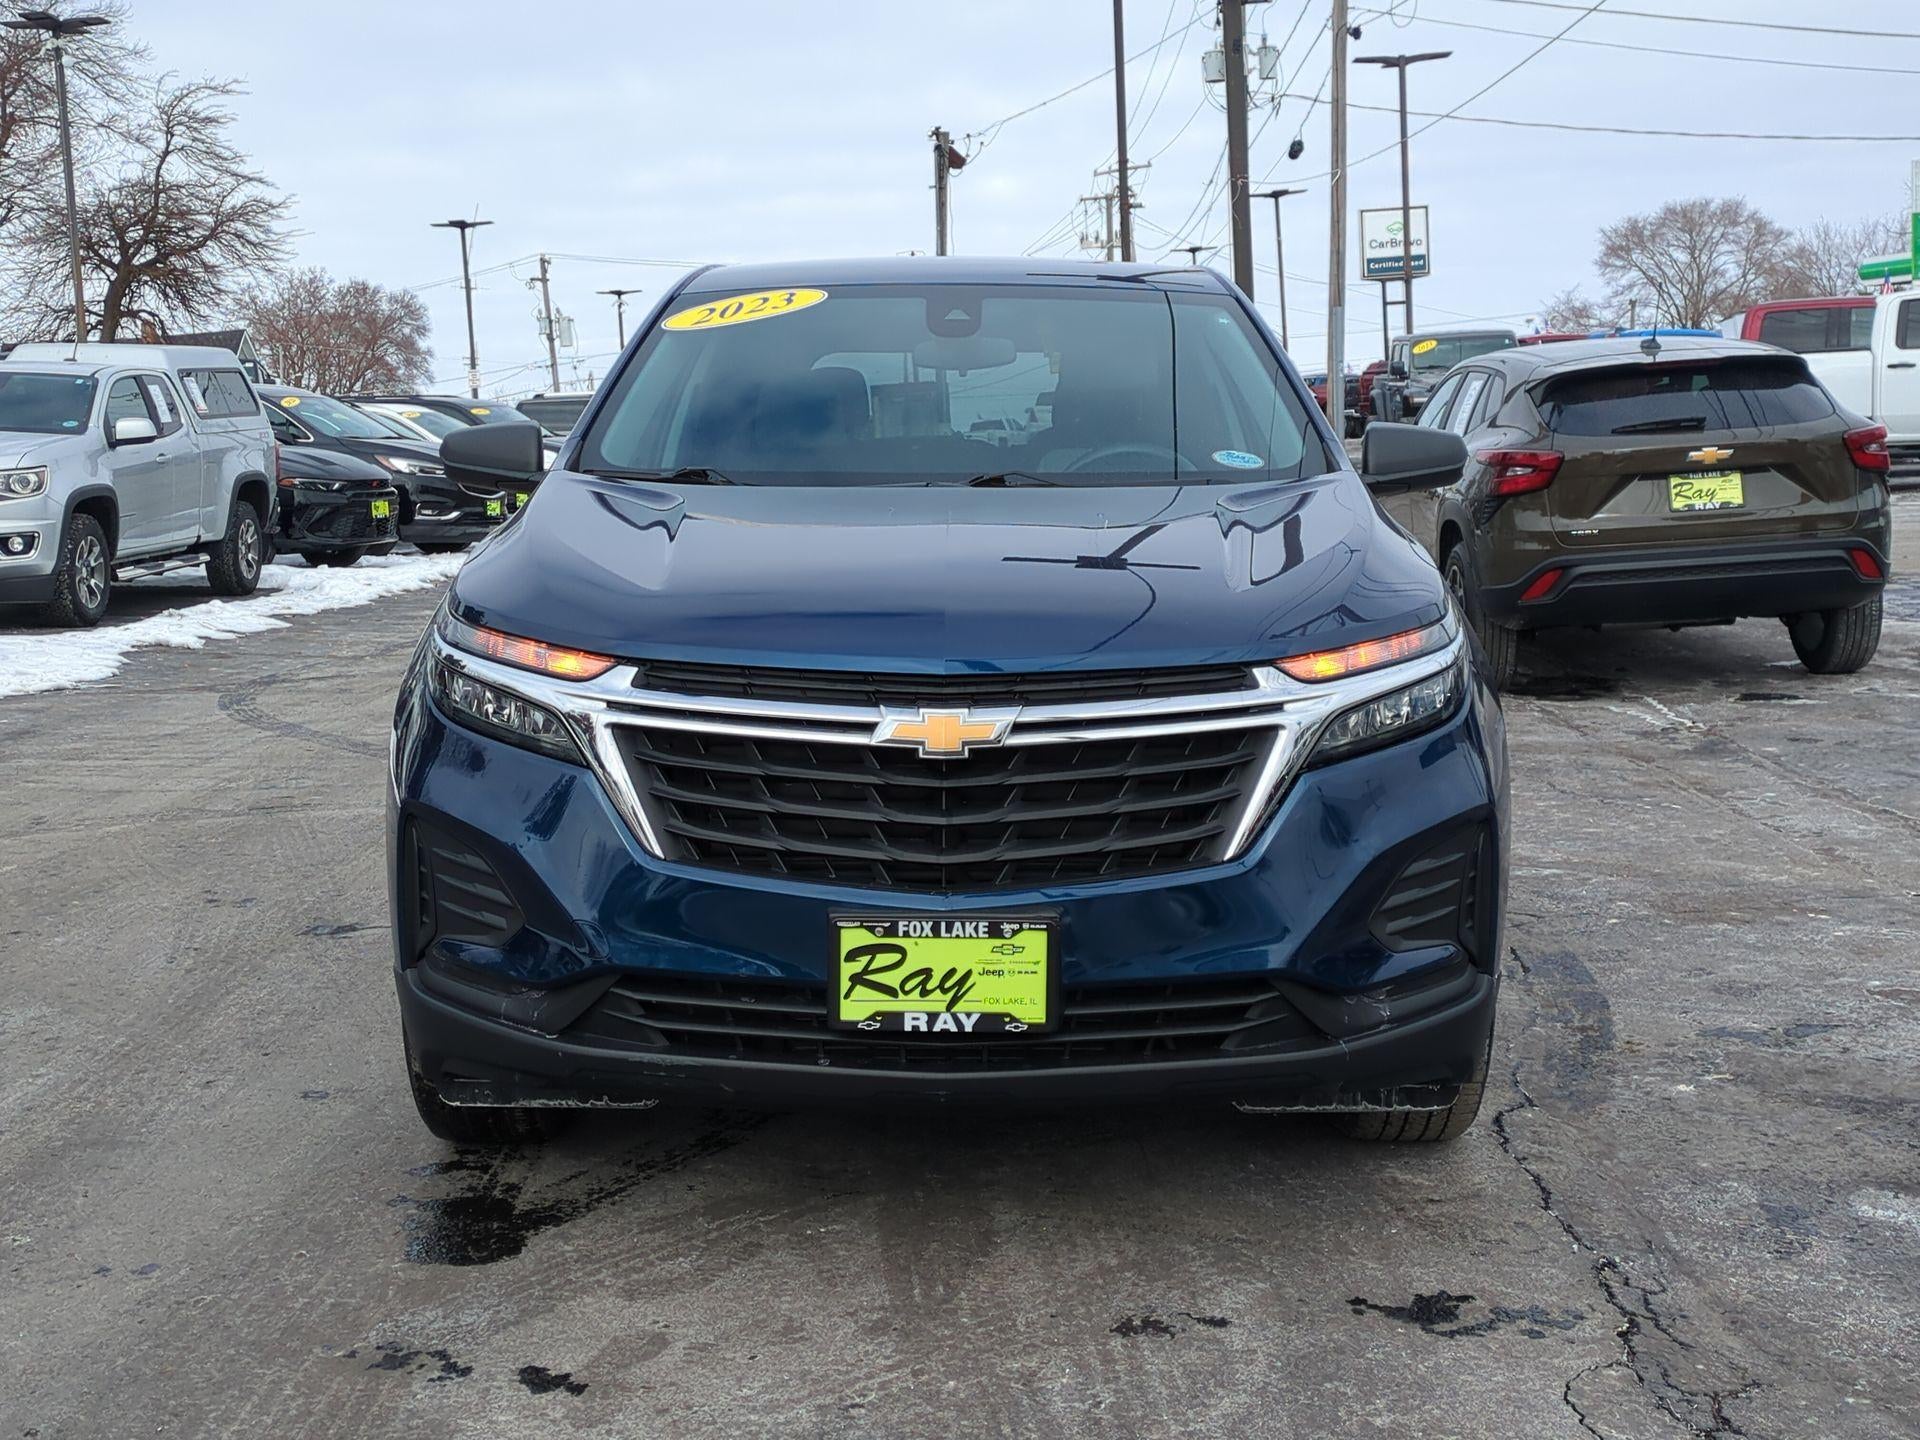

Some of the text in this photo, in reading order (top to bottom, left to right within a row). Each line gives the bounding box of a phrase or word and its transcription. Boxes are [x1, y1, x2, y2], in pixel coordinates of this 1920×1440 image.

[1369, 238, 1422, 249] CarBrvo
[1369, 261, 1403, 269] Certified
[690, 292, 797, 326] 2023
[1672, 481, 1719, 502] Ray
[1695, 502, 1721, 510] RAY
[898, 921, 989, 938] FOX LAKE
[1000, 922, 1020, 931] Jeep
[843, 943, 976, 1012] Ray
[978, 967, 1005, 979] Jeep
[983, 997, 1038, 1006] FOX LAKE, IL
[904, 1012, 981, 1032] RAY
